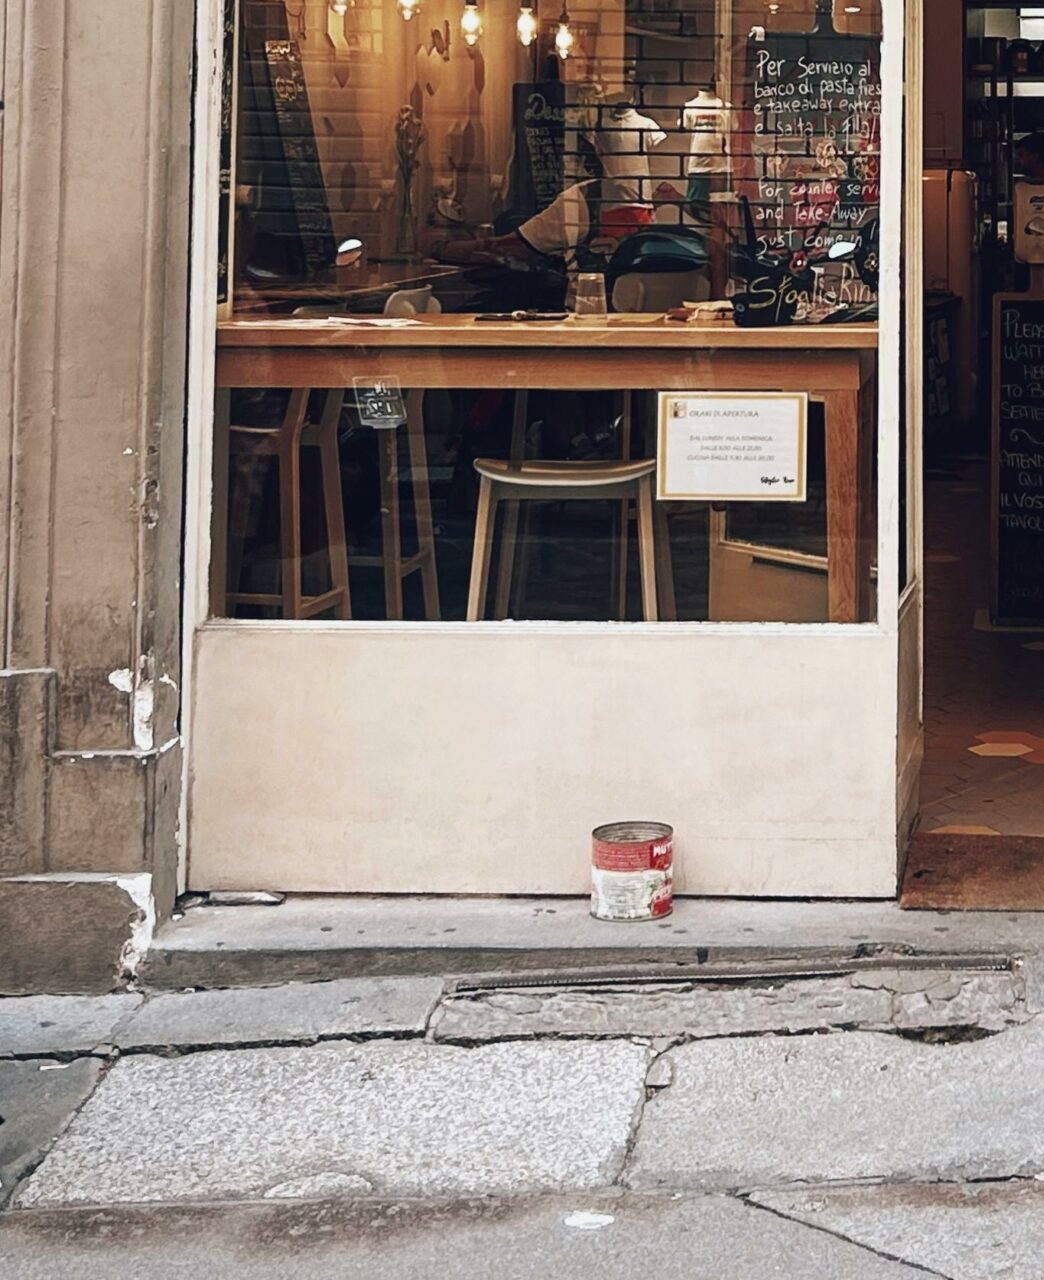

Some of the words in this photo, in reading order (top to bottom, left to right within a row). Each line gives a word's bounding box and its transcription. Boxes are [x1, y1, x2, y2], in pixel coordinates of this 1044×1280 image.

[756, 50, 786, 78] Per
[858, 59, 871, 77] al
[754, 81, 795, 99] banco
[799, 78, 813, 95] di
[820, 77, 855, 100] pasta
[753, 103, 763, 116] e
[754, 122, 763, 137] e
[758, 178, 784, 198] For
[755, 199, 785, 220] and
[1000, 383, 1023, 399] TO
[1018, 471, 1044, 488] QUI
